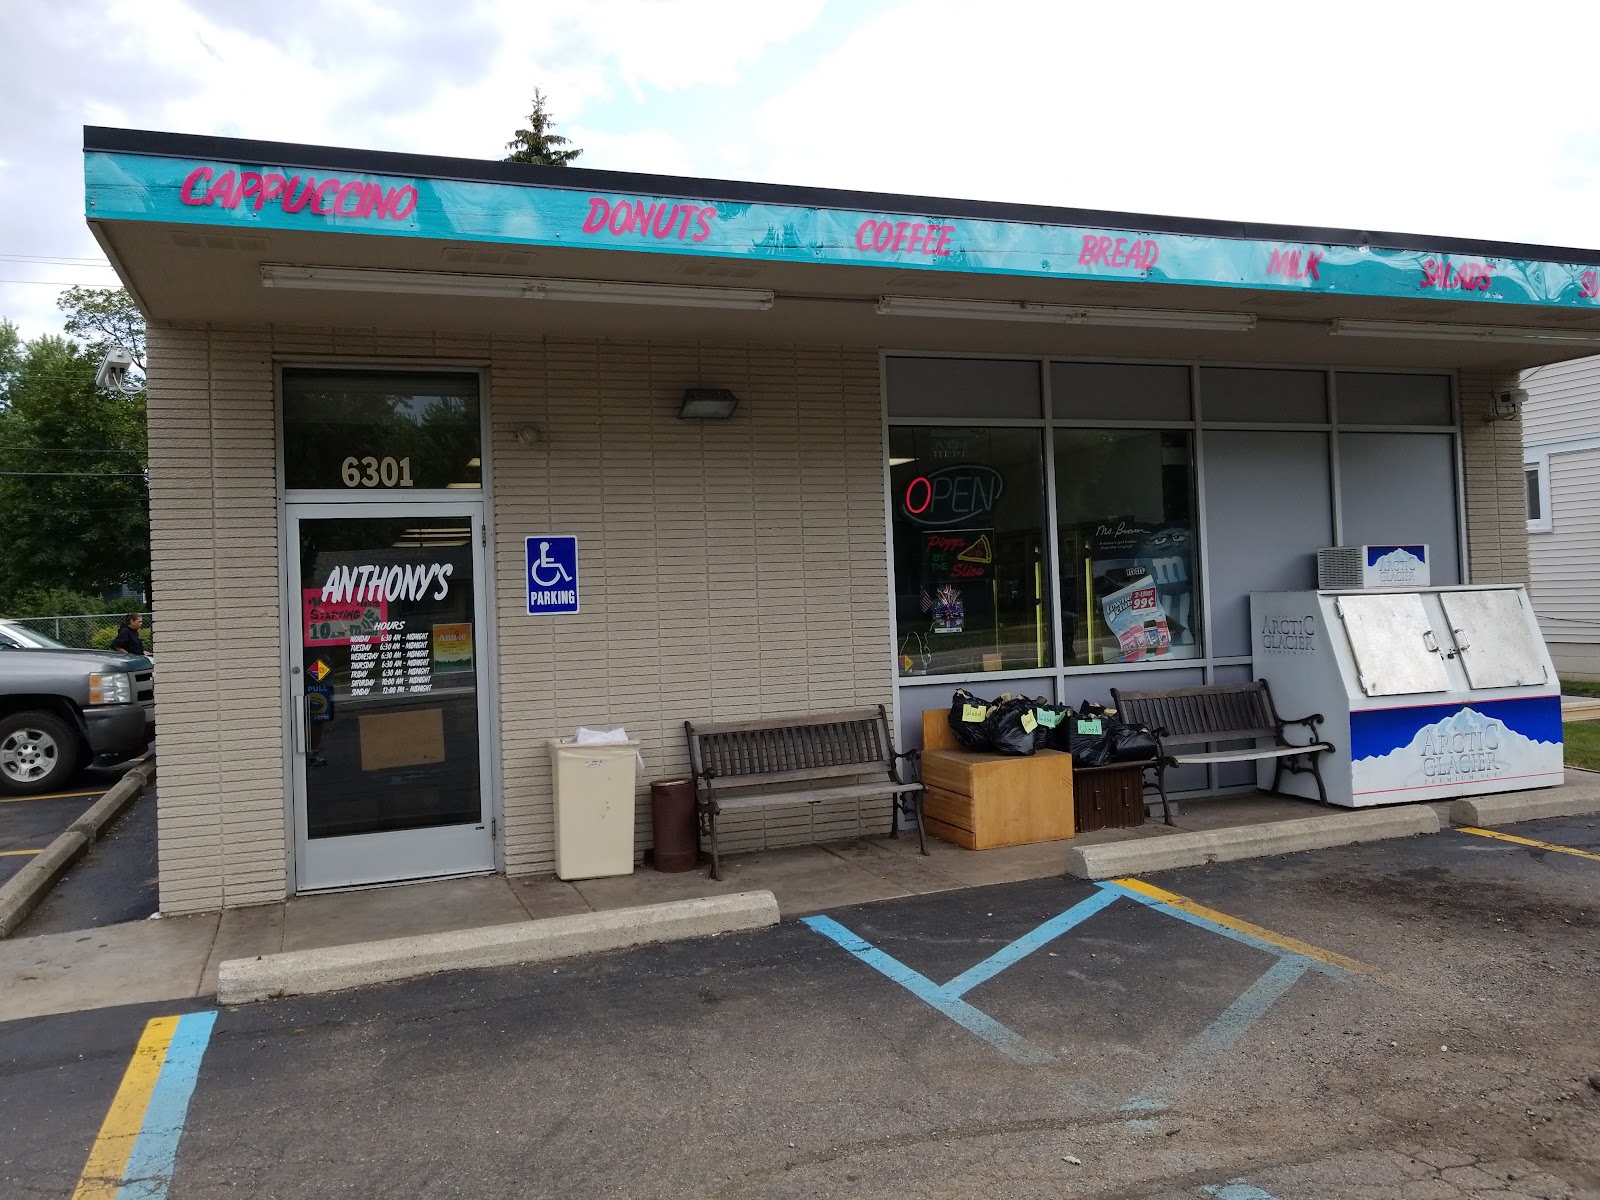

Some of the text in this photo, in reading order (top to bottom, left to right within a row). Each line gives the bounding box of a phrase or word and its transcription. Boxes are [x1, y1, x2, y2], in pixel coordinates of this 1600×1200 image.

[180, 166, 419, 221] CAPPUCCINO
[583, 196, 718, 242] DONUTS
[856, 217, 955, 256] COFFEE
[1078, 234, 1159, 271] BREAD
[1268, 247, 1322, 282] MILK
[1420, 259, 1494, 292] SALADS
[341, 456, 414, 488] 6301
[906, 476, 995, 513] OPEN
[321, 562, 454, 604] ANTHONY'S
[530, 590, 576, 606] PARKING
[373, 621, 406, 631] HOURS
[1261, 614, 1315, 636] ARCTIC
[1263, 634, 1316, 651] GLACIER
[1420, 723, 1499, 757] ARCTIC
[1423, 751, 1500, 777] GLACIER
